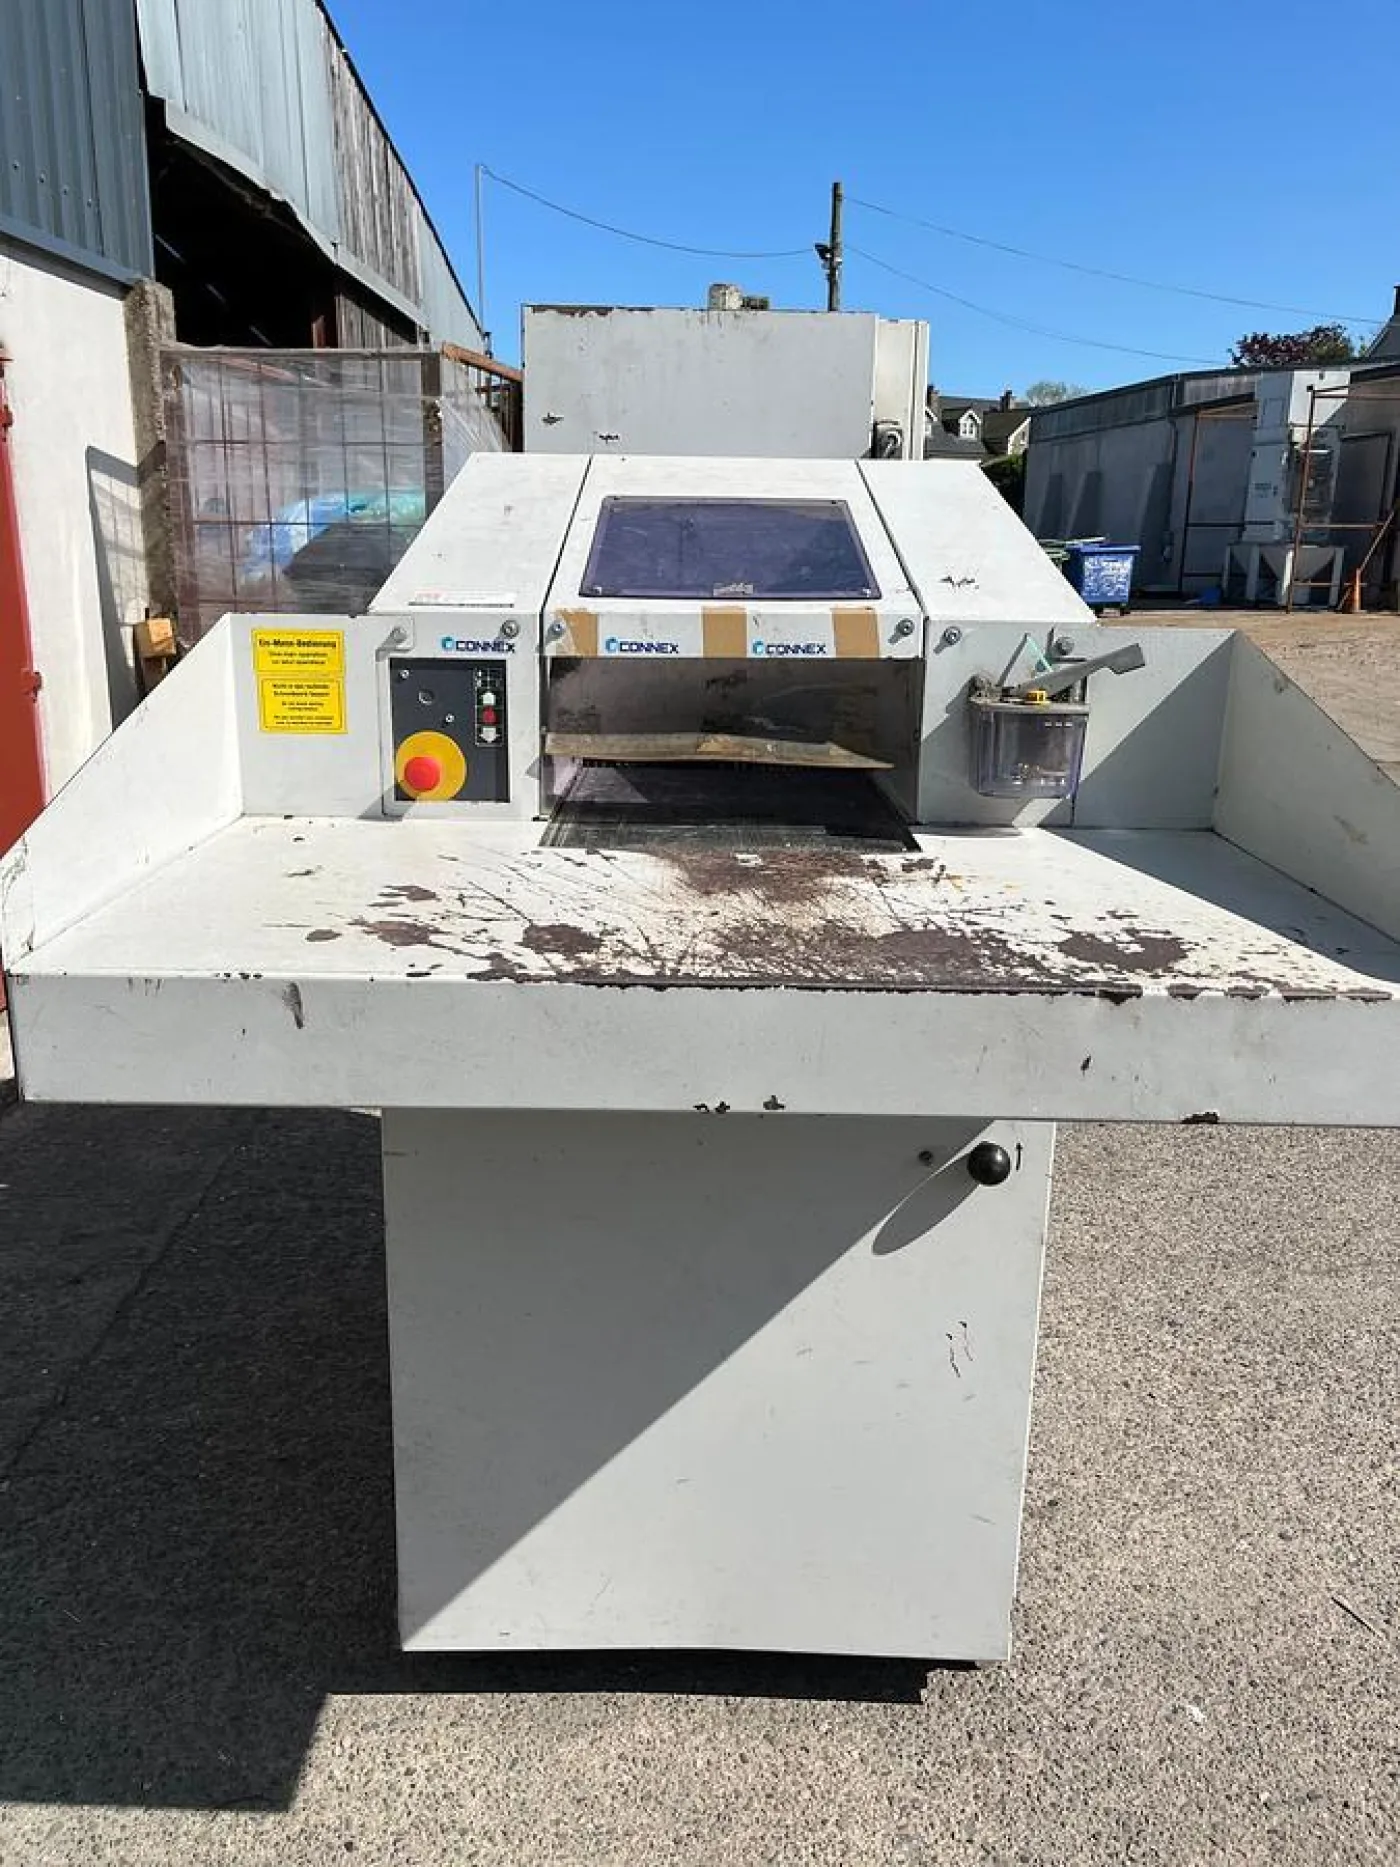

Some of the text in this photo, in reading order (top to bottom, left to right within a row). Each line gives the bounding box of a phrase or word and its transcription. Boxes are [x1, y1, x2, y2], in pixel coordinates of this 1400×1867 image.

[456, 640, 516, 654] CONNEX
[619, 641, 680, 655] CONNEX
[765, 642, 827, 656] CONNEX
